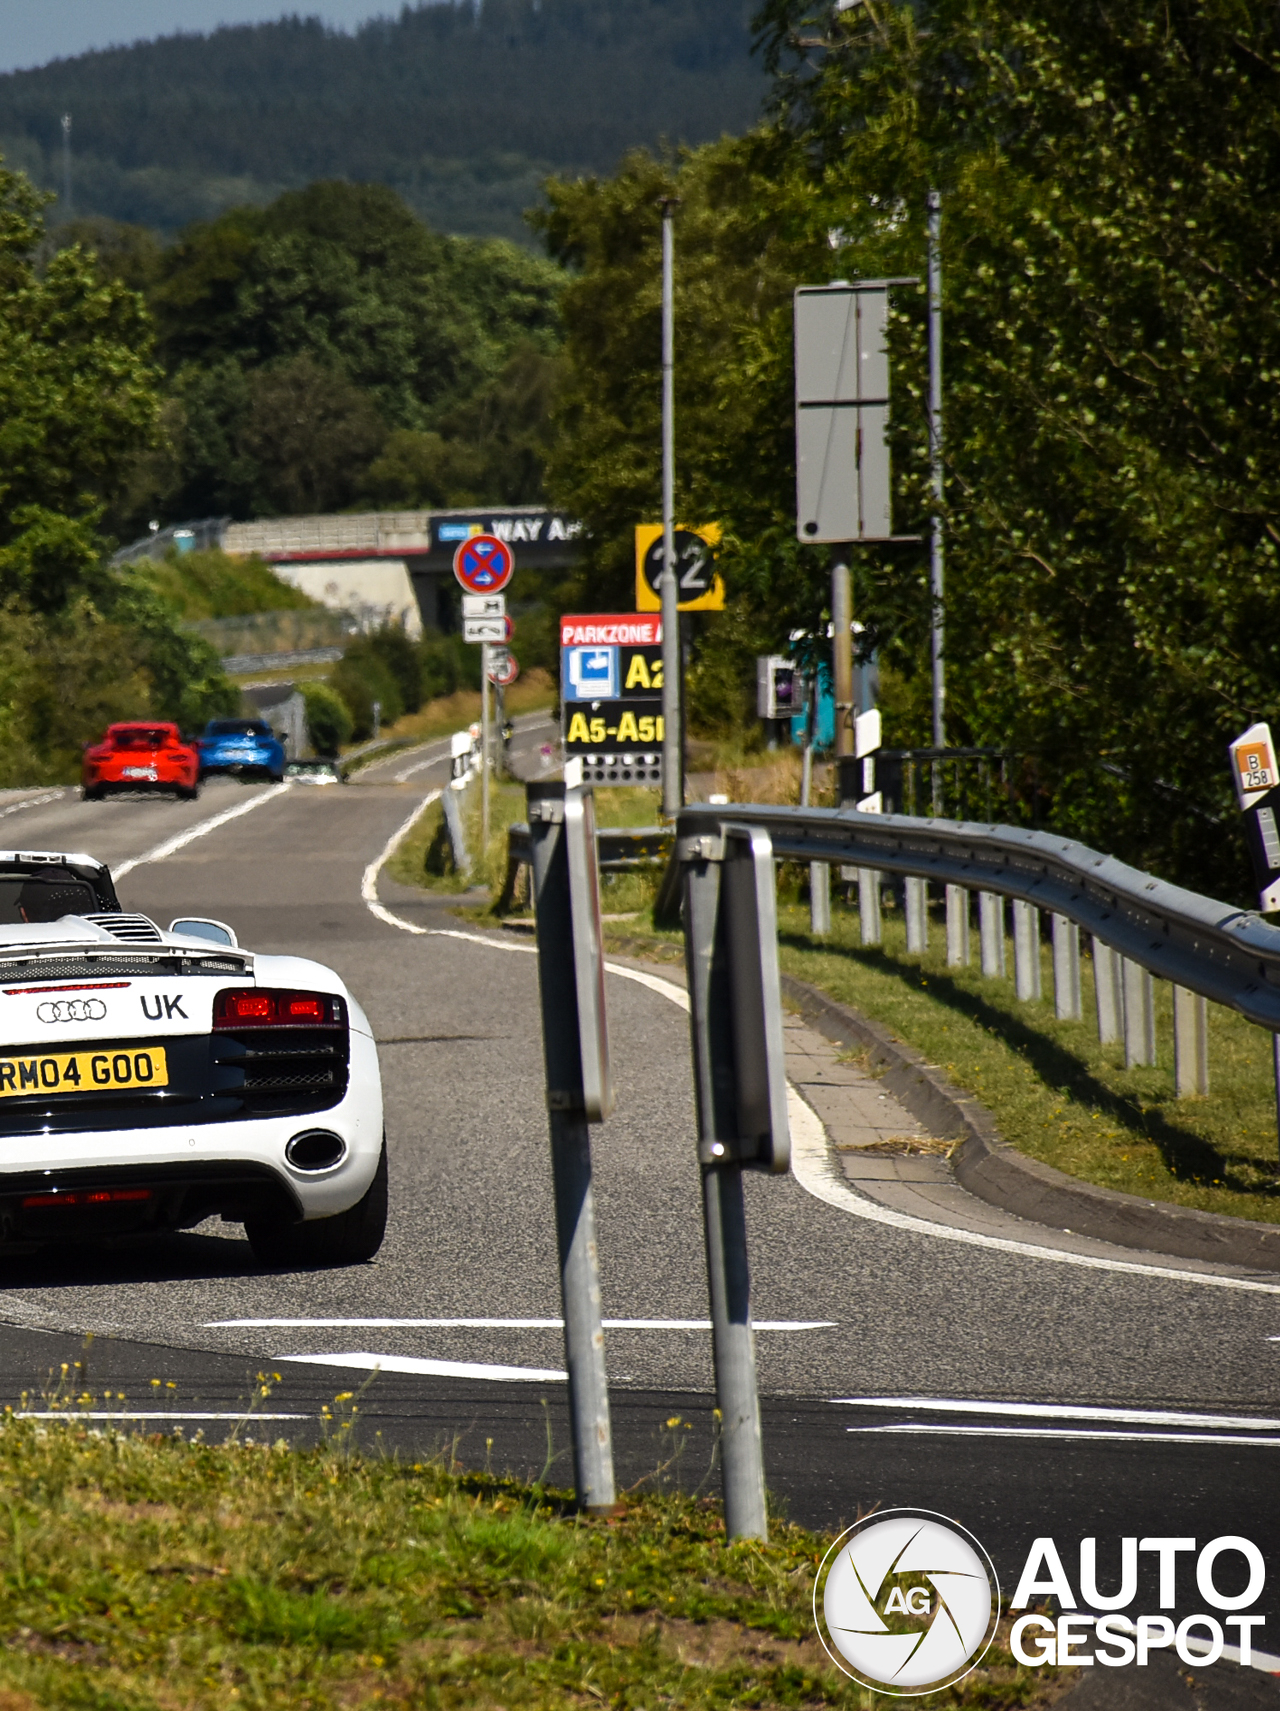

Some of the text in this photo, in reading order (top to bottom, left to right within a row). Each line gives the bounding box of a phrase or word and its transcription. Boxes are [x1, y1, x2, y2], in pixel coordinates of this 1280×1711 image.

[491, 518, 544, 542] WAY
[562, 624, 653, 644] PARKZONE
[1248, 755, 1259, 770] B
[1246, 771, 1268, 787] 258
[140, 995, 189, 1020] UK
[91, 1053, 153, 1084] GOO
